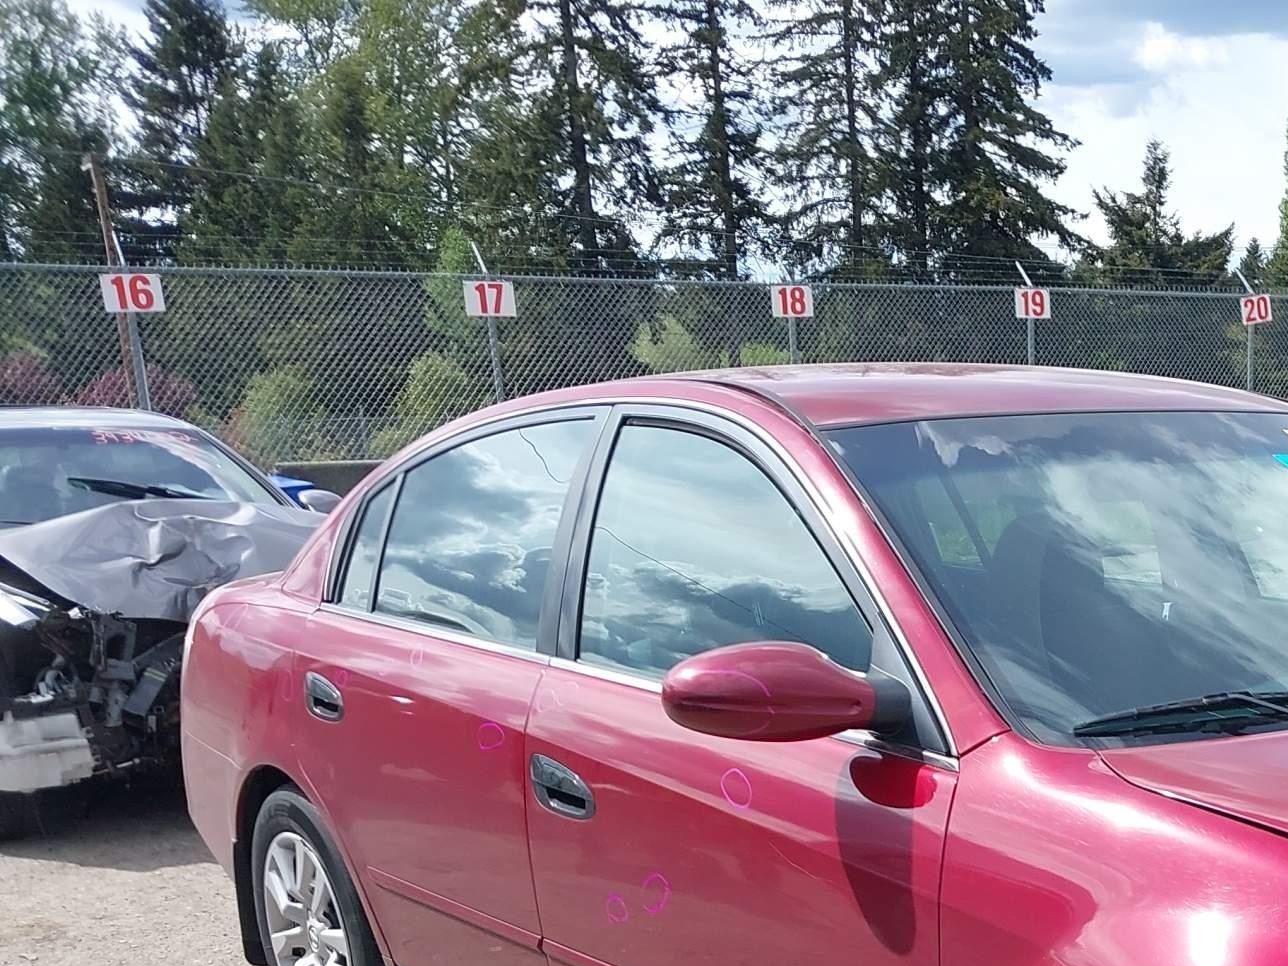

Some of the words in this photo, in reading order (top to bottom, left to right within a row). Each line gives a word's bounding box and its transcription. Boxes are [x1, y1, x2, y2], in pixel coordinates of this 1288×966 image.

[111, 275, 155, 310] 16
[474, 282, 504, 313] 17
[779, 287, 807, 316] 18
[1022, 291, 1045, 317] 19
[1243, 295, 1270, 324] 20
